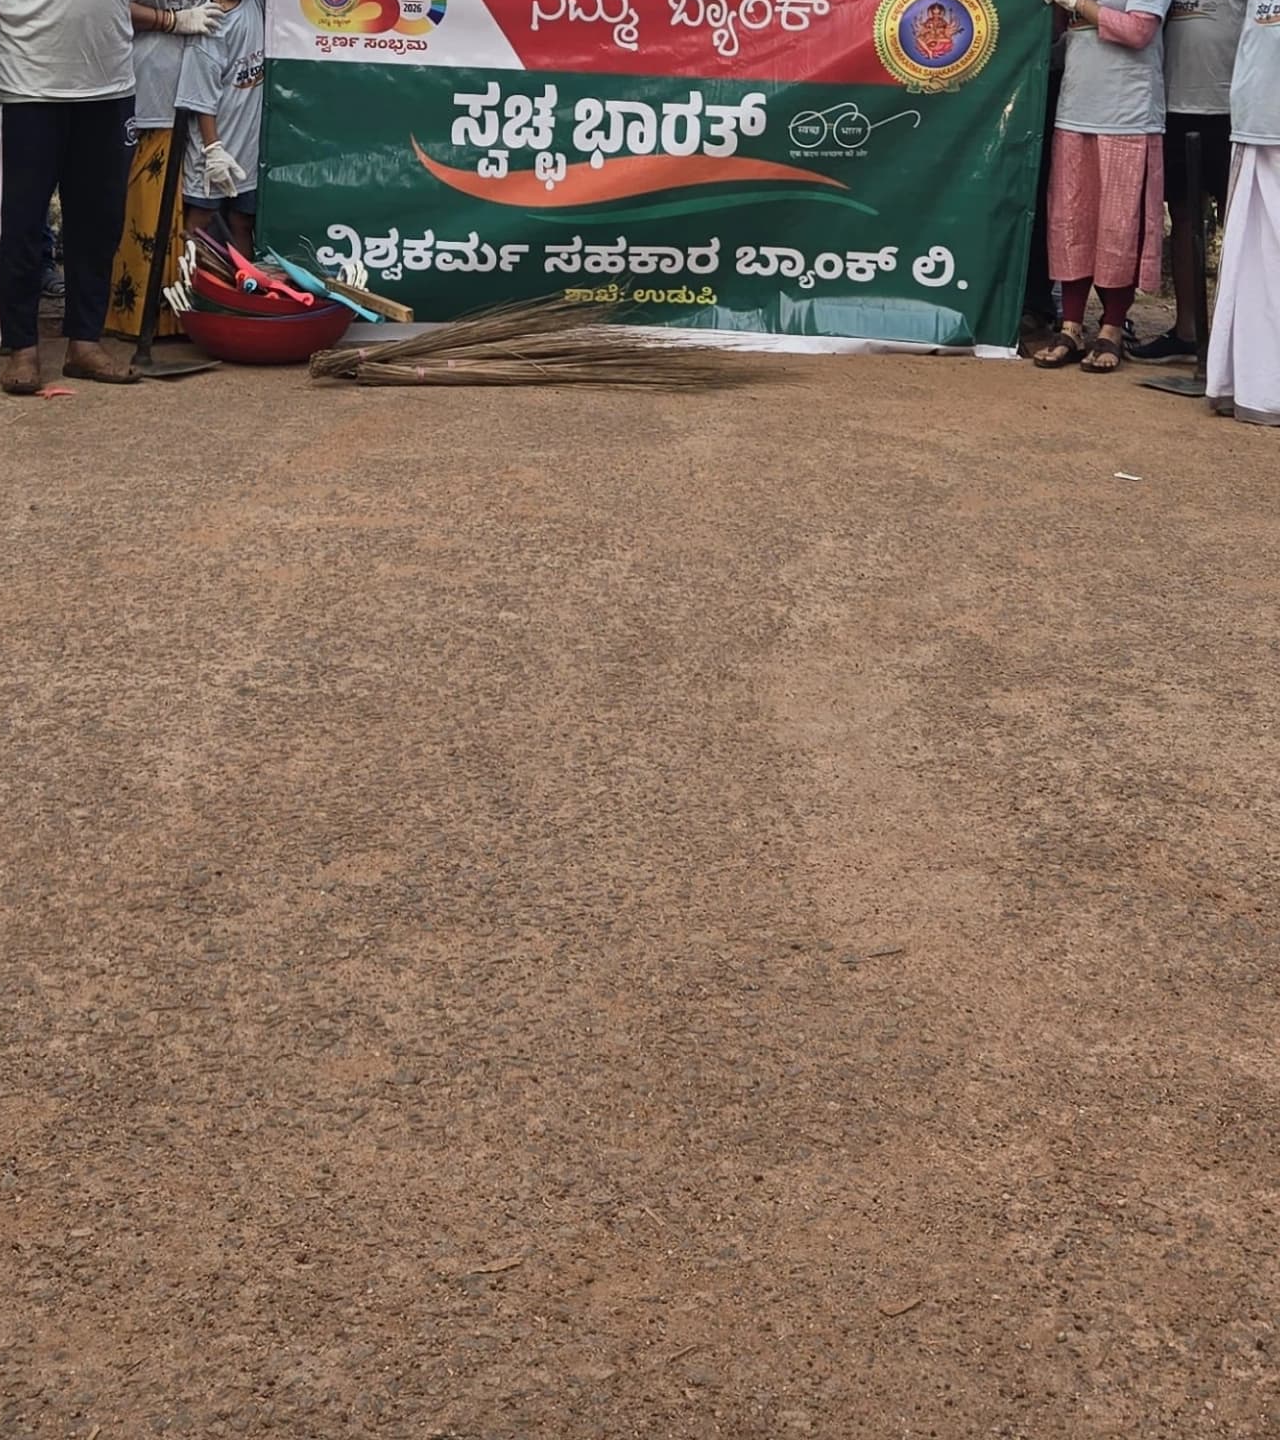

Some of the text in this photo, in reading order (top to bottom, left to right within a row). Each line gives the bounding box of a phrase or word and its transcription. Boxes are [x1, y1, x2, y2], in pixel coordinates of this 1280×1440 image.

[403, 3, 422, 13] 2026
[315, 35, 428, 55] ಸ್ವರ್ಣ ಸಂಭ್ರಮ
[451, 81, 767, 191] ಸ್ವಚ್ಛ ಭಾರತ್
[316, 224, 968, 290] ವಿಶ್ವಕರ್ಮ ಸಹಕಾರ ಬ್ಯಾಂಕ್ ಲಿ.
[633, 285, 717, 305] ಉಡುಪಿ
